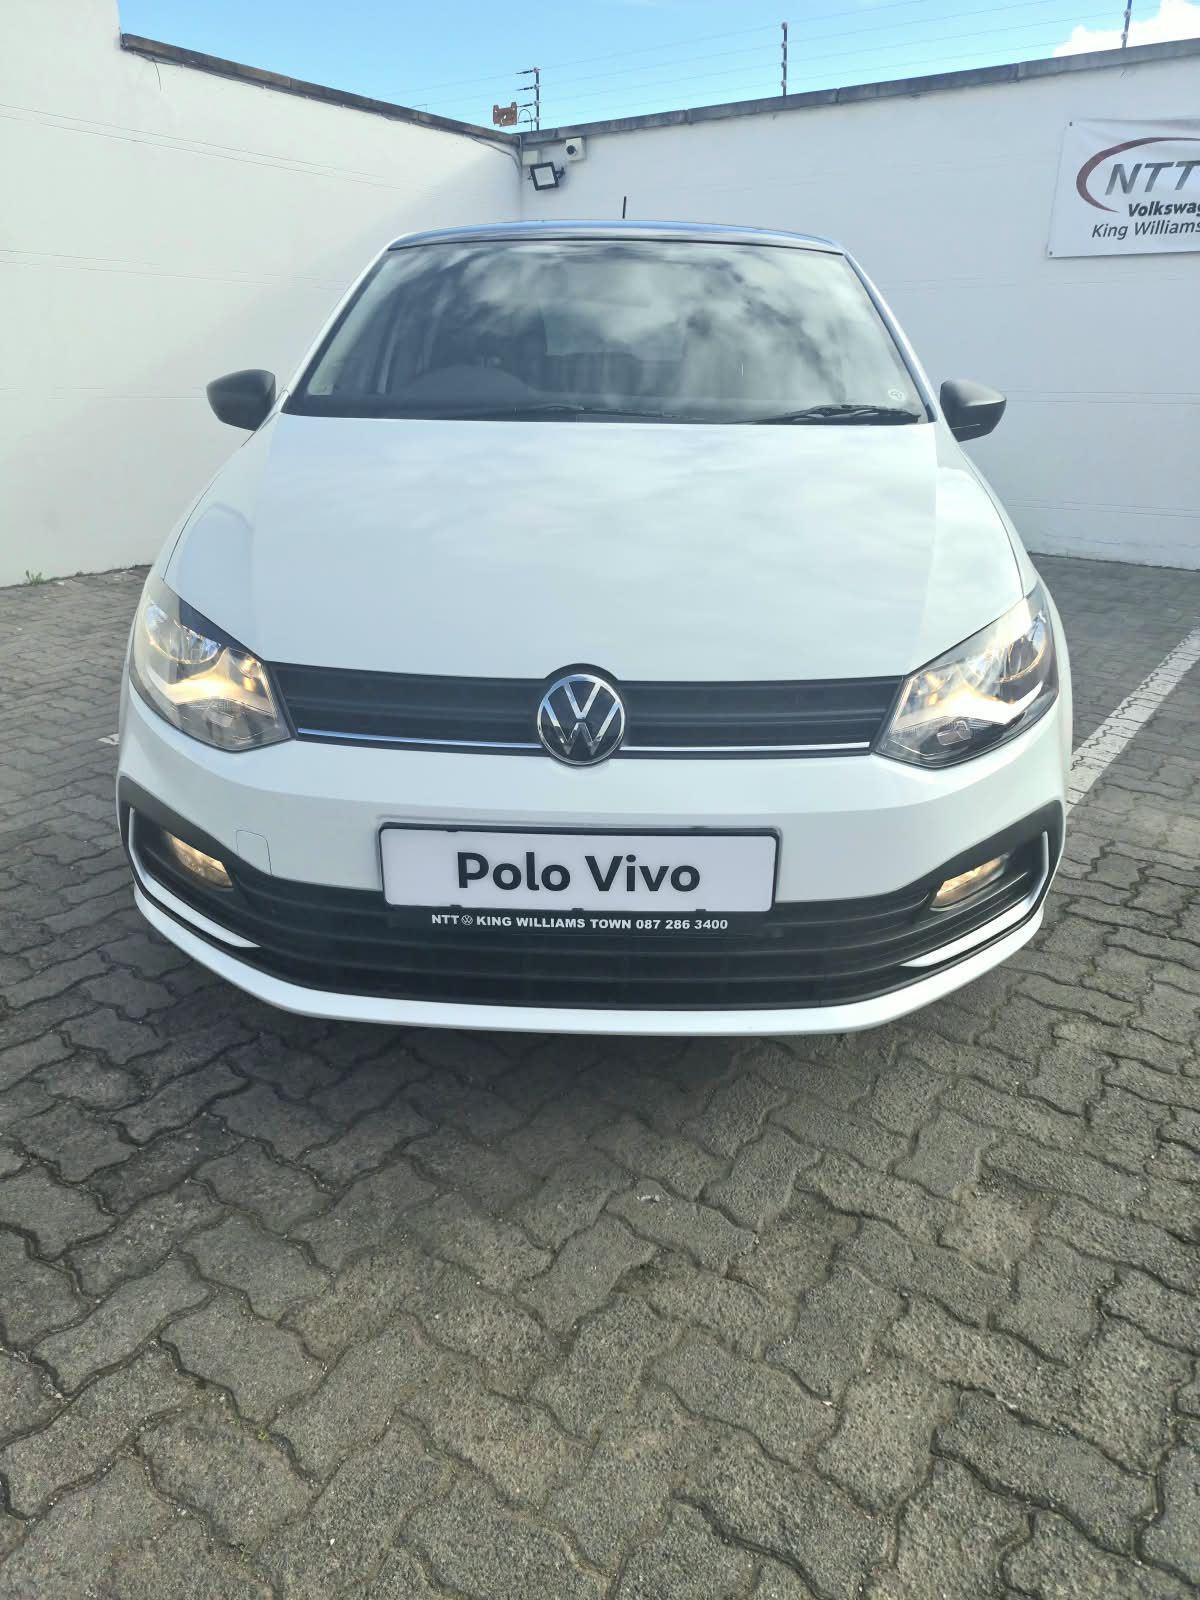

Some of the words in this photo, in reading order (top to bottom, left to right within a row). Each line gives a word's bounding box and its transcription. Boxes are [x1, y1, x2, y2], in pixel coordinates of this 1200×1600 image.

[1105, 160, 1200, 196] NTT
[1092, 223, 1128, 240] King
[456, 851, 571, 892] Polo
[584, 854, 701, 892] Vivo
[431, 914, 460, 925] NTT
[476, 915, 512, 927] KING
[516, 917, 586, 928] WILLIAMS
[590, 919, 632, 929] TOWN
[635, 919, 661, 929] 087
[665, 919, 691, 930] 286
[694, 919, 729, 929] 3400
